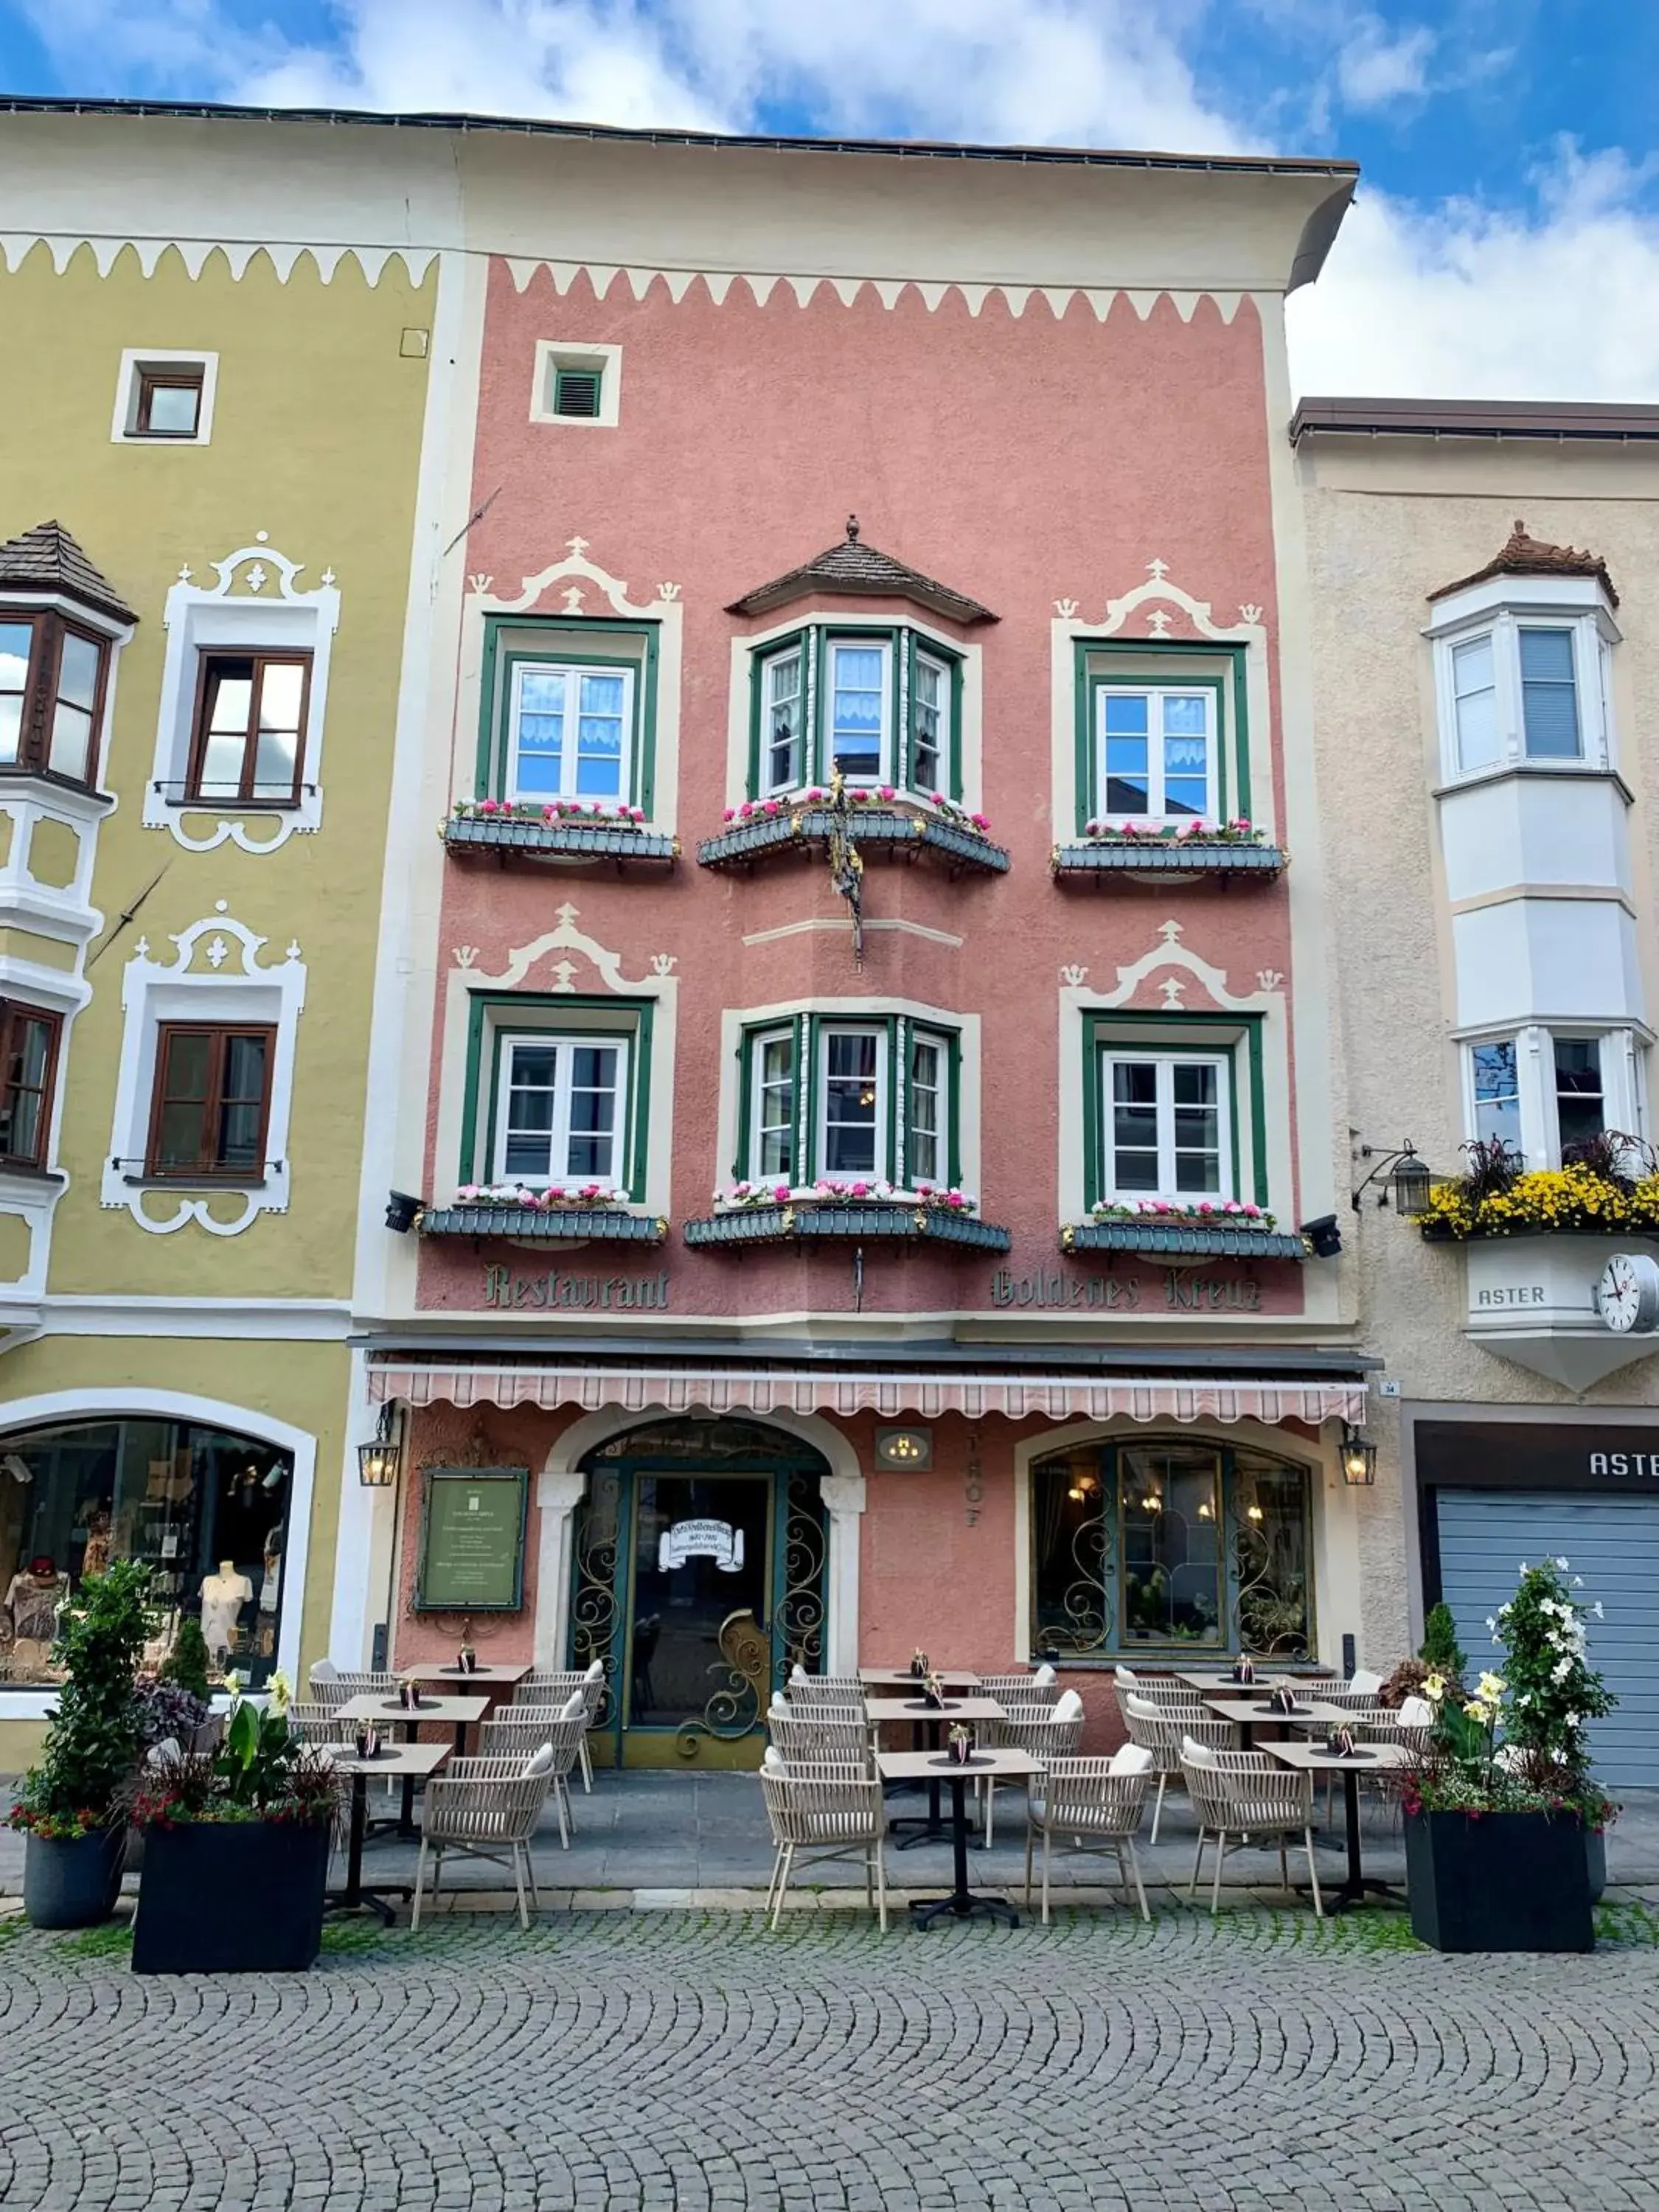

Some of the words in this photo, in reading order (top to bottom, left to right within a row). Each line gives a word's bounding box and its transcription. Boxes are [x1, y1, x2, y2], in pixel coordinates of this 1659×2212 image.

[483, 1262, 671, 1310] Restaurant
[991, 1267, 1141, 1310] Goldenes
[1164, 1267, 1262, 1311] Kreuz
[1478, 1287, 1545, 1305] ASTER
[1590, 1453, 1659, 1477] ASTE
